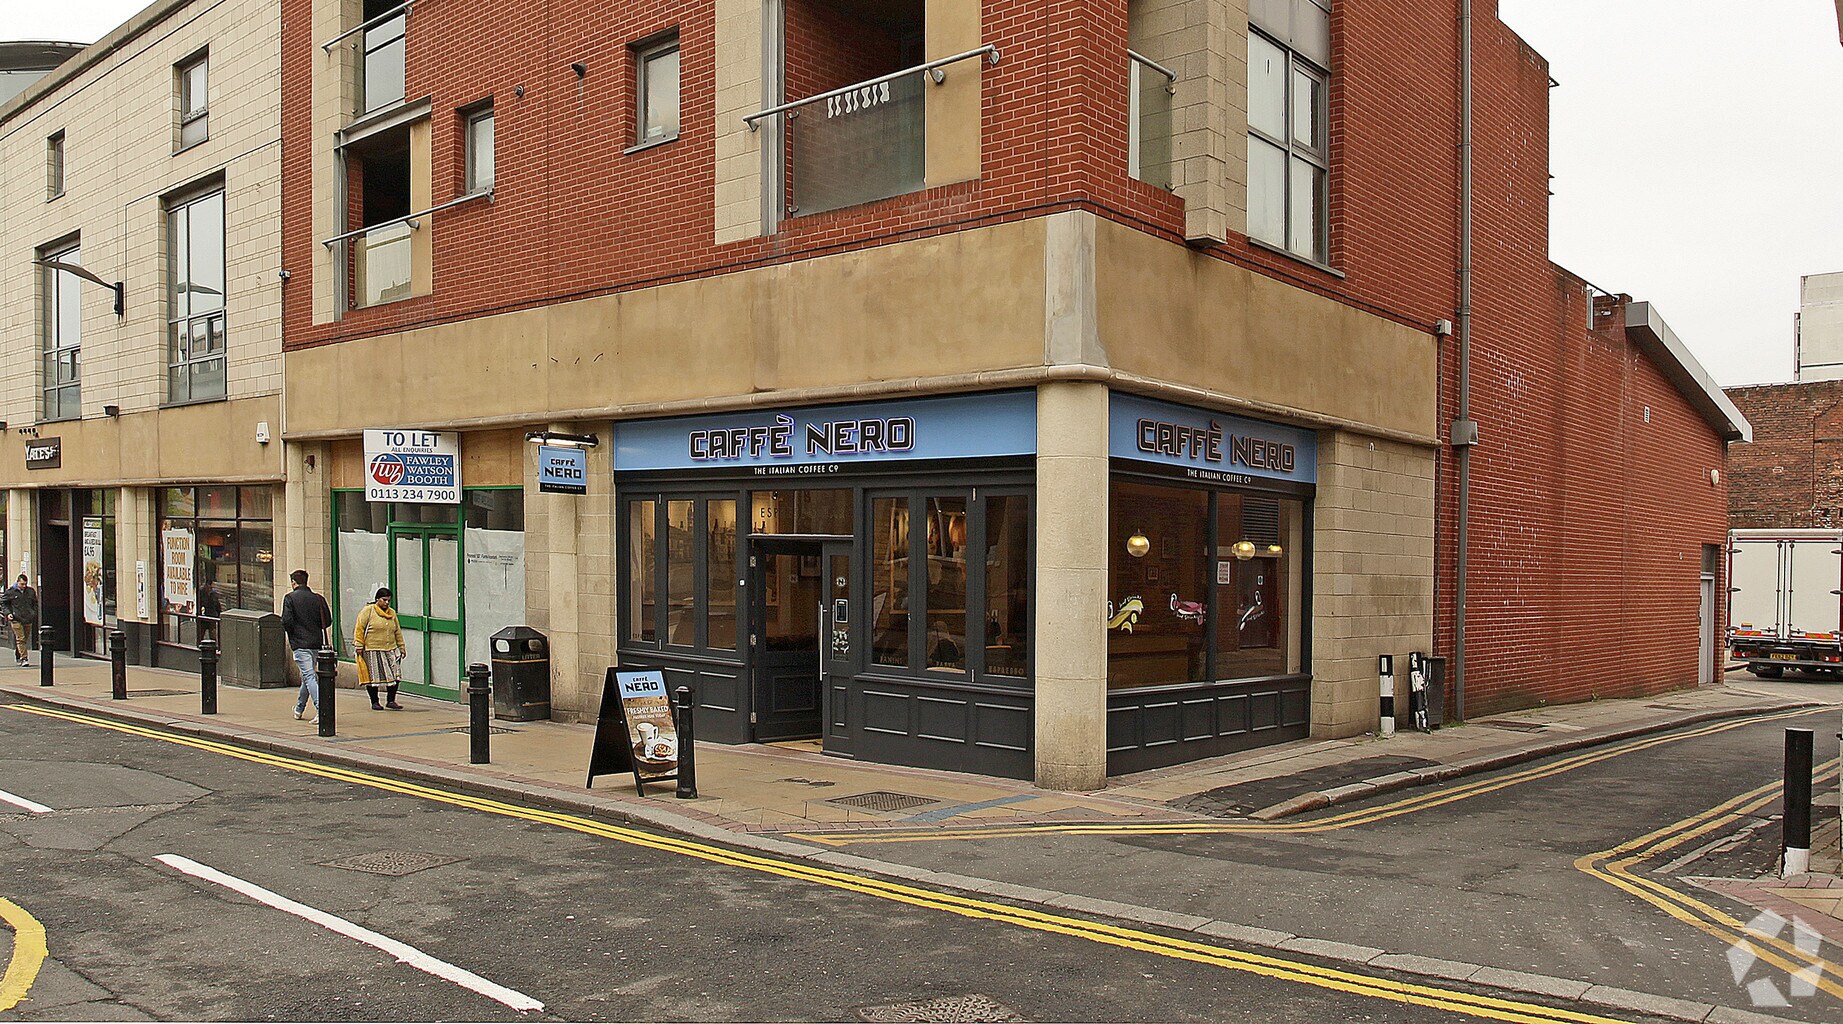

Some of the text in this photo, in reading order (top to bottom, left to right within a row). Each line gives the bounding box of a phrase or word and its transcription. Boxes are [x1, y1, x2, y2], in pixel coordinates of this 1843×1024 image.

[383, 432, 441, 447] TO LET
[689, 414, 916, 460] CAFFÈ NERO
[1137, 419, 1295, 472] CAFFÈ NERO
[406, 456, 449, 466] FAWLEY
[406, 466, 453, 475] WATSON
[544, 467, 582, 479] NERO
[799, 465, 826, 474] COFFEE
[407, 476, 448, 485] BOOTH
[1187, 469, 1198, 478] THE
[1199, 471, 1221, 480] ITALIAN
[1222, 474, 1243, 483] COFFEE
[371, 489, 456, 500] 0113 234 7900
[171, 552, 186, 565] ROOM
[170, 581, 177, 595] TO
[624, 681, 659, 693] NERO
